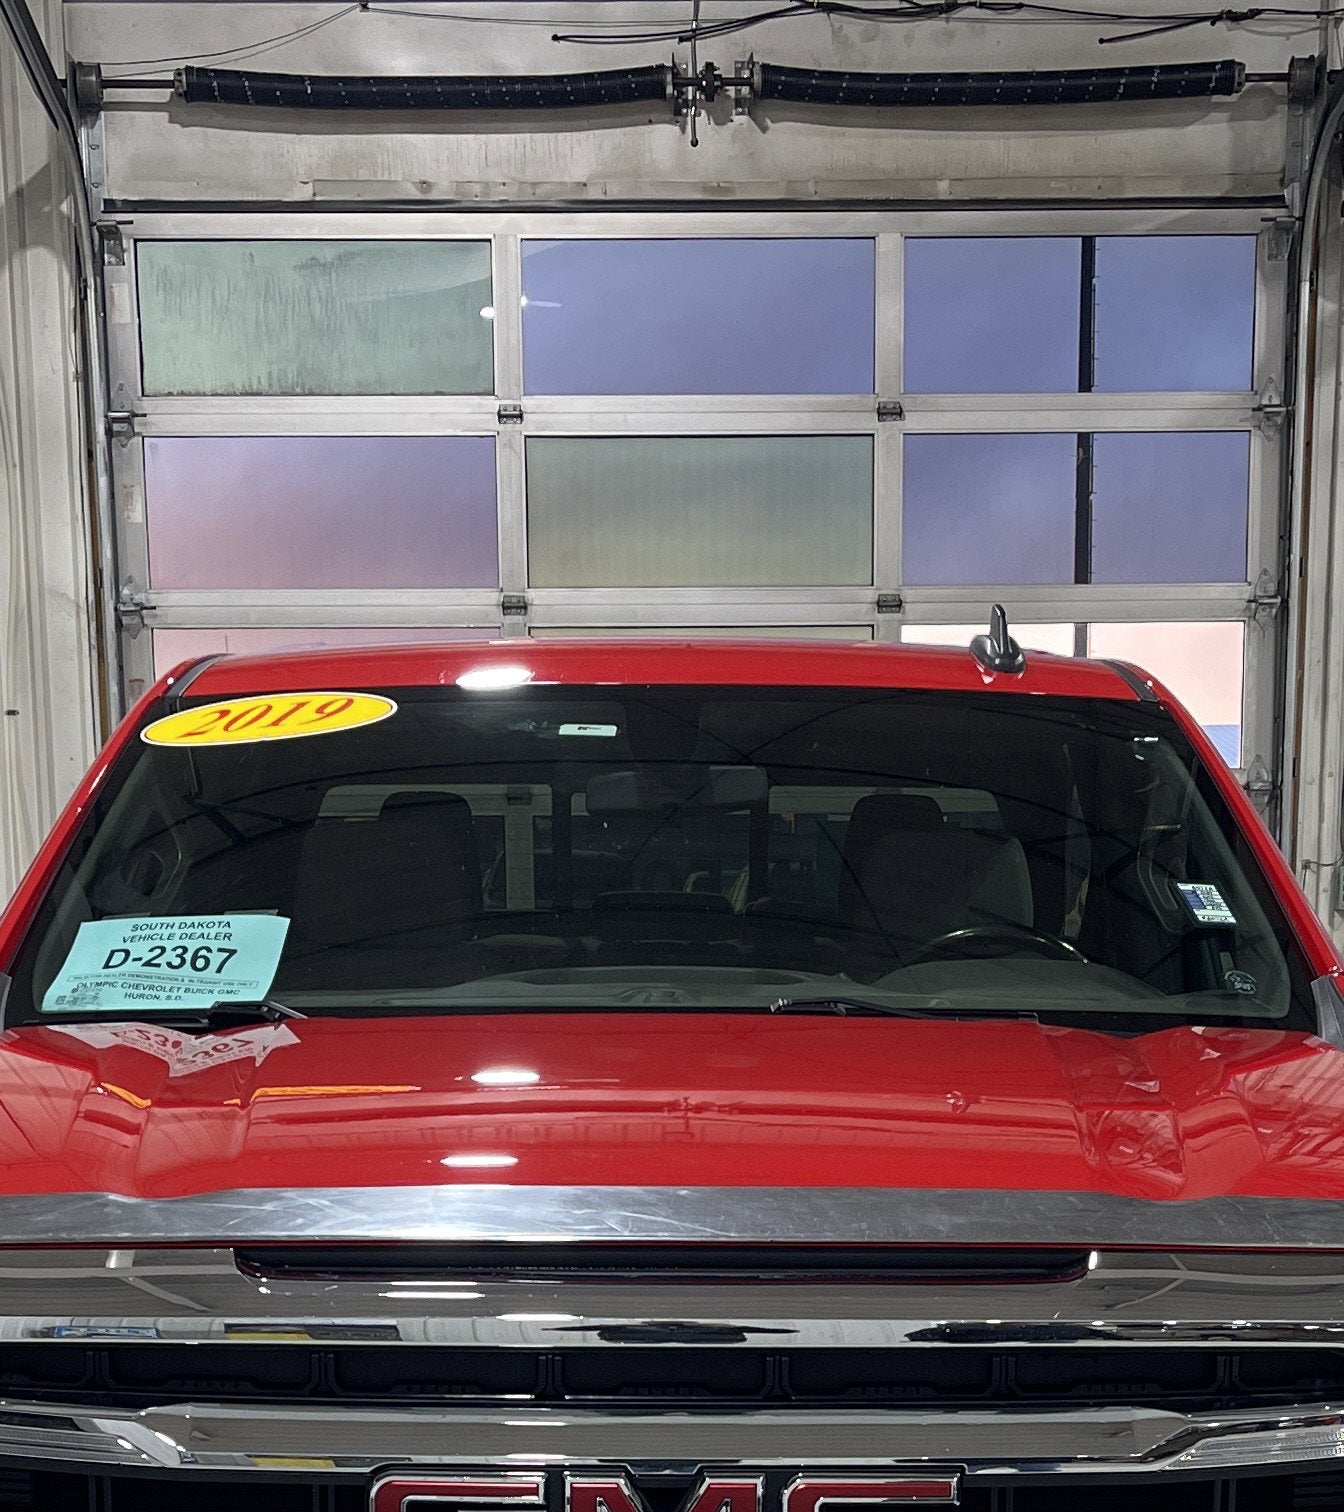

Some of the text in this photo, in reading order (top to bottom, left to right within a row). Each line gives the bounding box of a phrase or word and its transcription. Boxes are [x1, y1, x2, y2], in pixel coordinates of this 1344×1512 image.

[177, 697, 355, 739] 2019
[130, 920, 232, 932] SOUTH DAKOTA
[122, 932, 233, 944] VEHICLE DEALER
[102, 945, 238, 974] D-2367
[76, 981, 119, 990] OLYMPIC
[120, 981, 182, 995] CHEVROLET
[183, 987, 215, 995] BUICK
